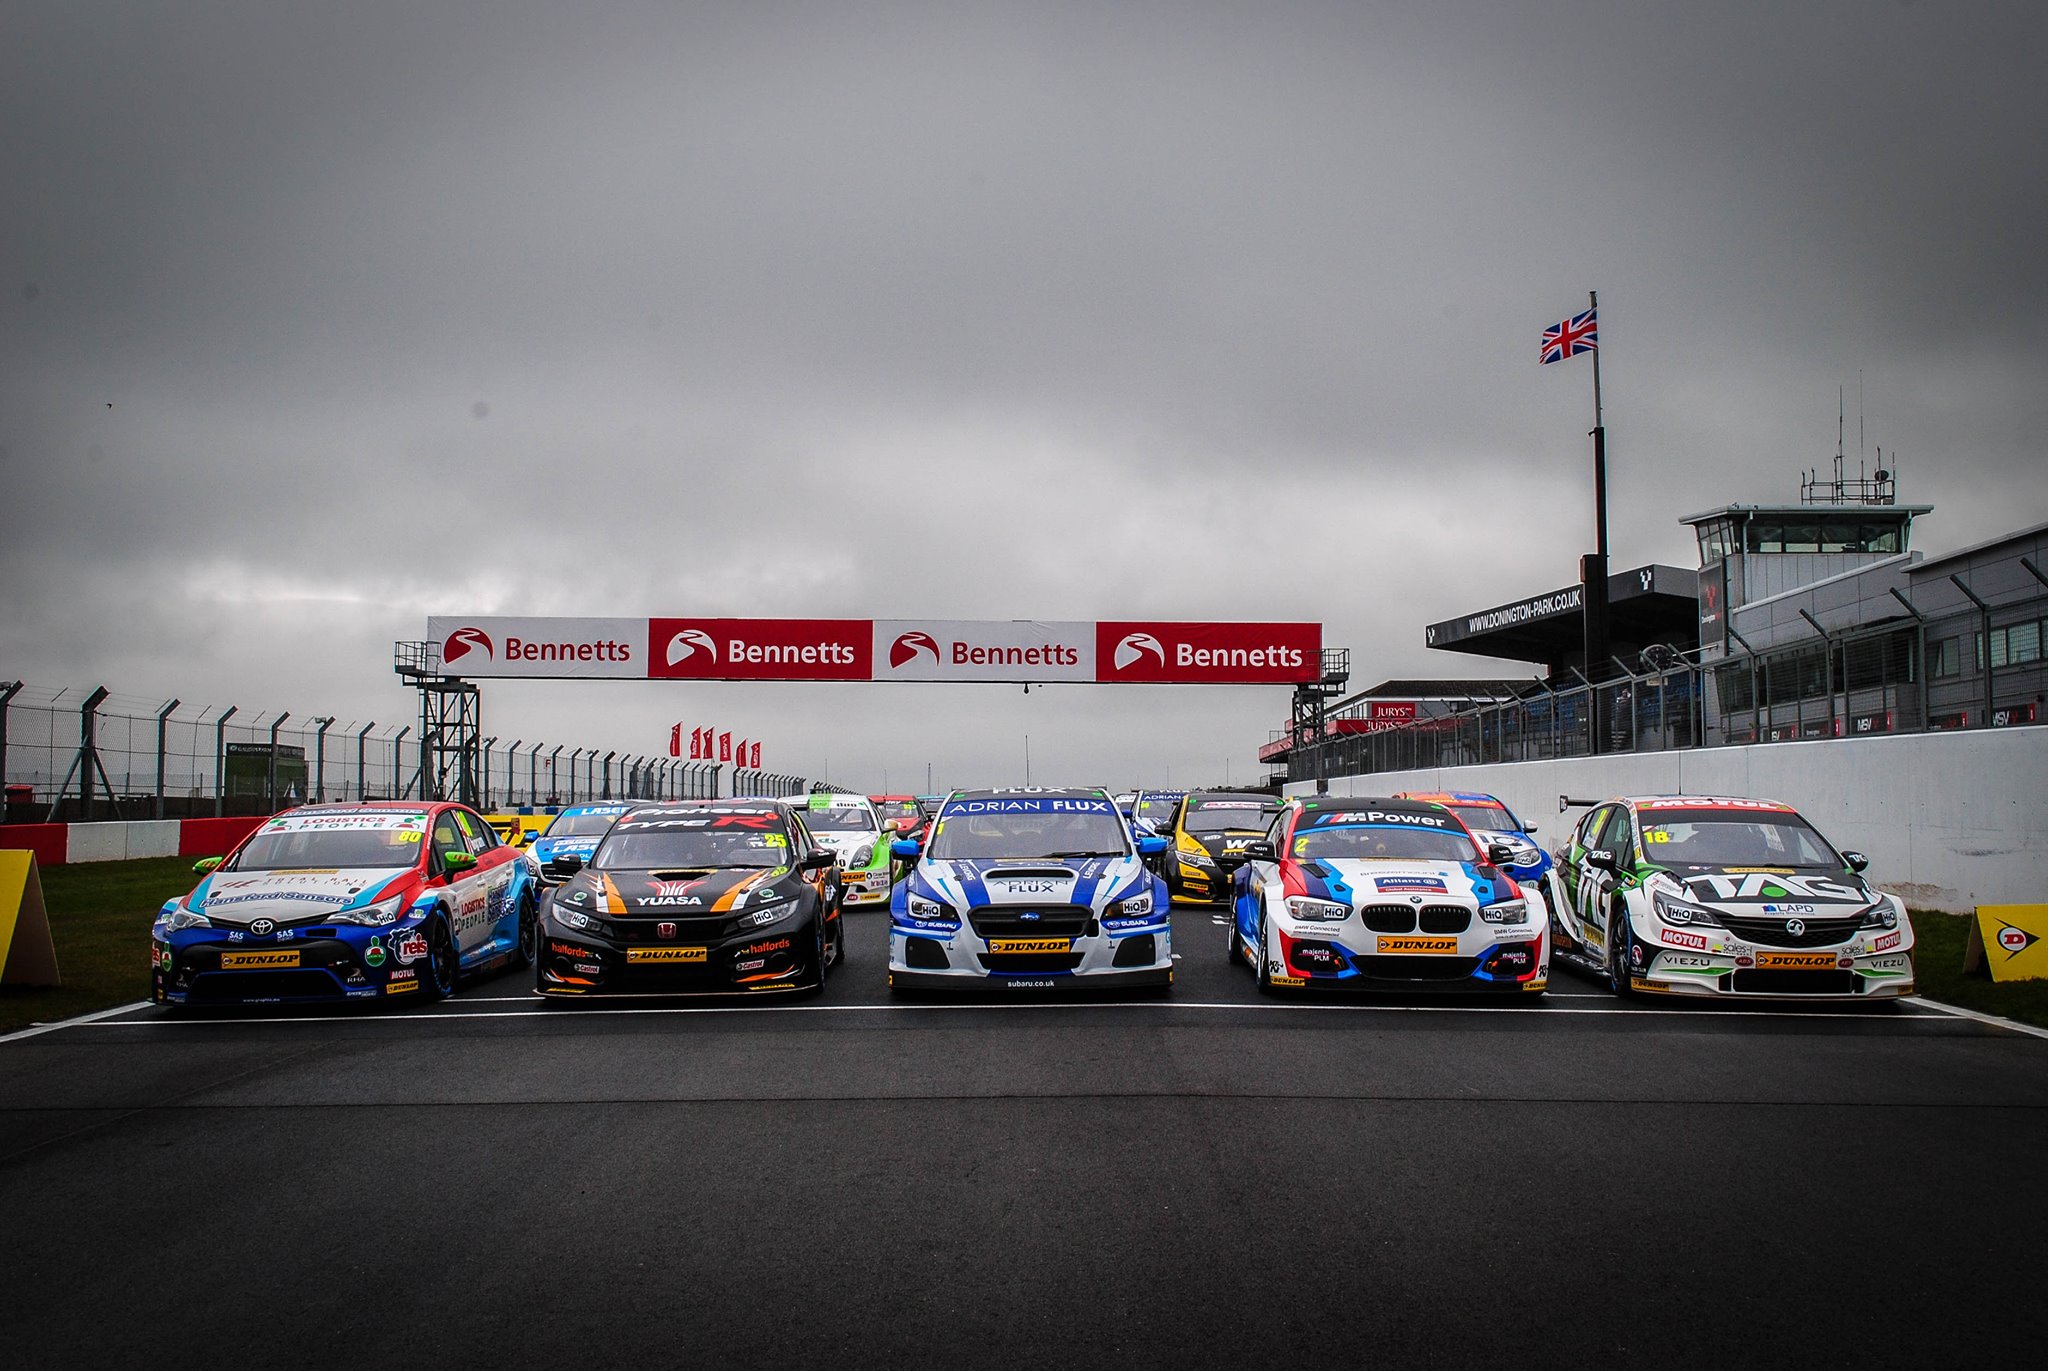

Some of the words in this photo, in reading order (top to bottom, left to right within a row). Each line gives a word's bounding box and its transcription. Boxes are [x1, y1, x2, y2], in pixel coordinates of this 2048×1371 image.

[1468, 589, 1581, 633] WWW.DONINGTON-PARK.CO.UK
[505, 637, 631, 662] Bennetts
[728, 640, 855, 665] Bennetts
[951, 641, 1078, 666] Bennetts
[1176, 643, 1303, 668] Bennetts
[1376, 707, 1405, 718] JURYS
[950, 801, 1040, 813] ADRIAN
[1053, 801, 1108, 812] FLUX
[1651, 800, 1777, 809] MOTUL
[627, 808, 772, 816] Pioneer
[304, 817, 387, 825] LOGISTICS
[618, 820, 711, 830] TYPE
[399, 831, 422, 842] 80
[764, 834, 787, 847] 25
[1644, 832, 1669, 844] 18
[1294, 838, 1309, 853] 2
[1591, 850, 1612, 859] TAG
[1681, 874, 1865, 902] TAG
[199, 892, 281, 907] Hansford
[283, 892, 354, 905] Sensors
[637, 897, 702, 906] YUASA
[461, 897, 485, 916] LOGISTICS
[922, 905, 939, 916] HiQ
[1124, 904, 1140, 912] HiQ
[378, 912, 394, 923] HiQ
[754, 911, 772, 922] HiQ
[1325, 908, 1343, 917] HiQ
[1485, 910, 1502, 919] HiQ
[1672, 909, 1690, 919] HiQ
[1884, 913, 1895, 922] HiQ
[462, 912, 485, 929] PEOPLE
[572, 913, 587, 926] HiQ
[229, 931, 244, 939] SAS
[277, 930, 294, 939] SAS
[1663, 931, 1704, 948] MOTUL
[403, 936, 427, 955] reis
[552, 942, 587, 958] halfords
[750, 939, 790, 954] halfords
[1004, 942, 1069, 950] DUNLOP
[1391, 941, 1457, 949] DUNLOP
[234, 954, 300, 965] DUNLOP
[640, 950, 706, 959] DUNLOP
[744, 960, 763, 969] Castrol
[1664, 957, 1710, 966] VIEZU
[1771, 957, 1835, 965] DUNLOP
[1871, 959, 1904, 968] VIEZU
[392, 969, 415, 979] MOTUL
[393, 982, 418, 991] DUNLOP
[1638, 981, 1669, 989] DUNLOP
